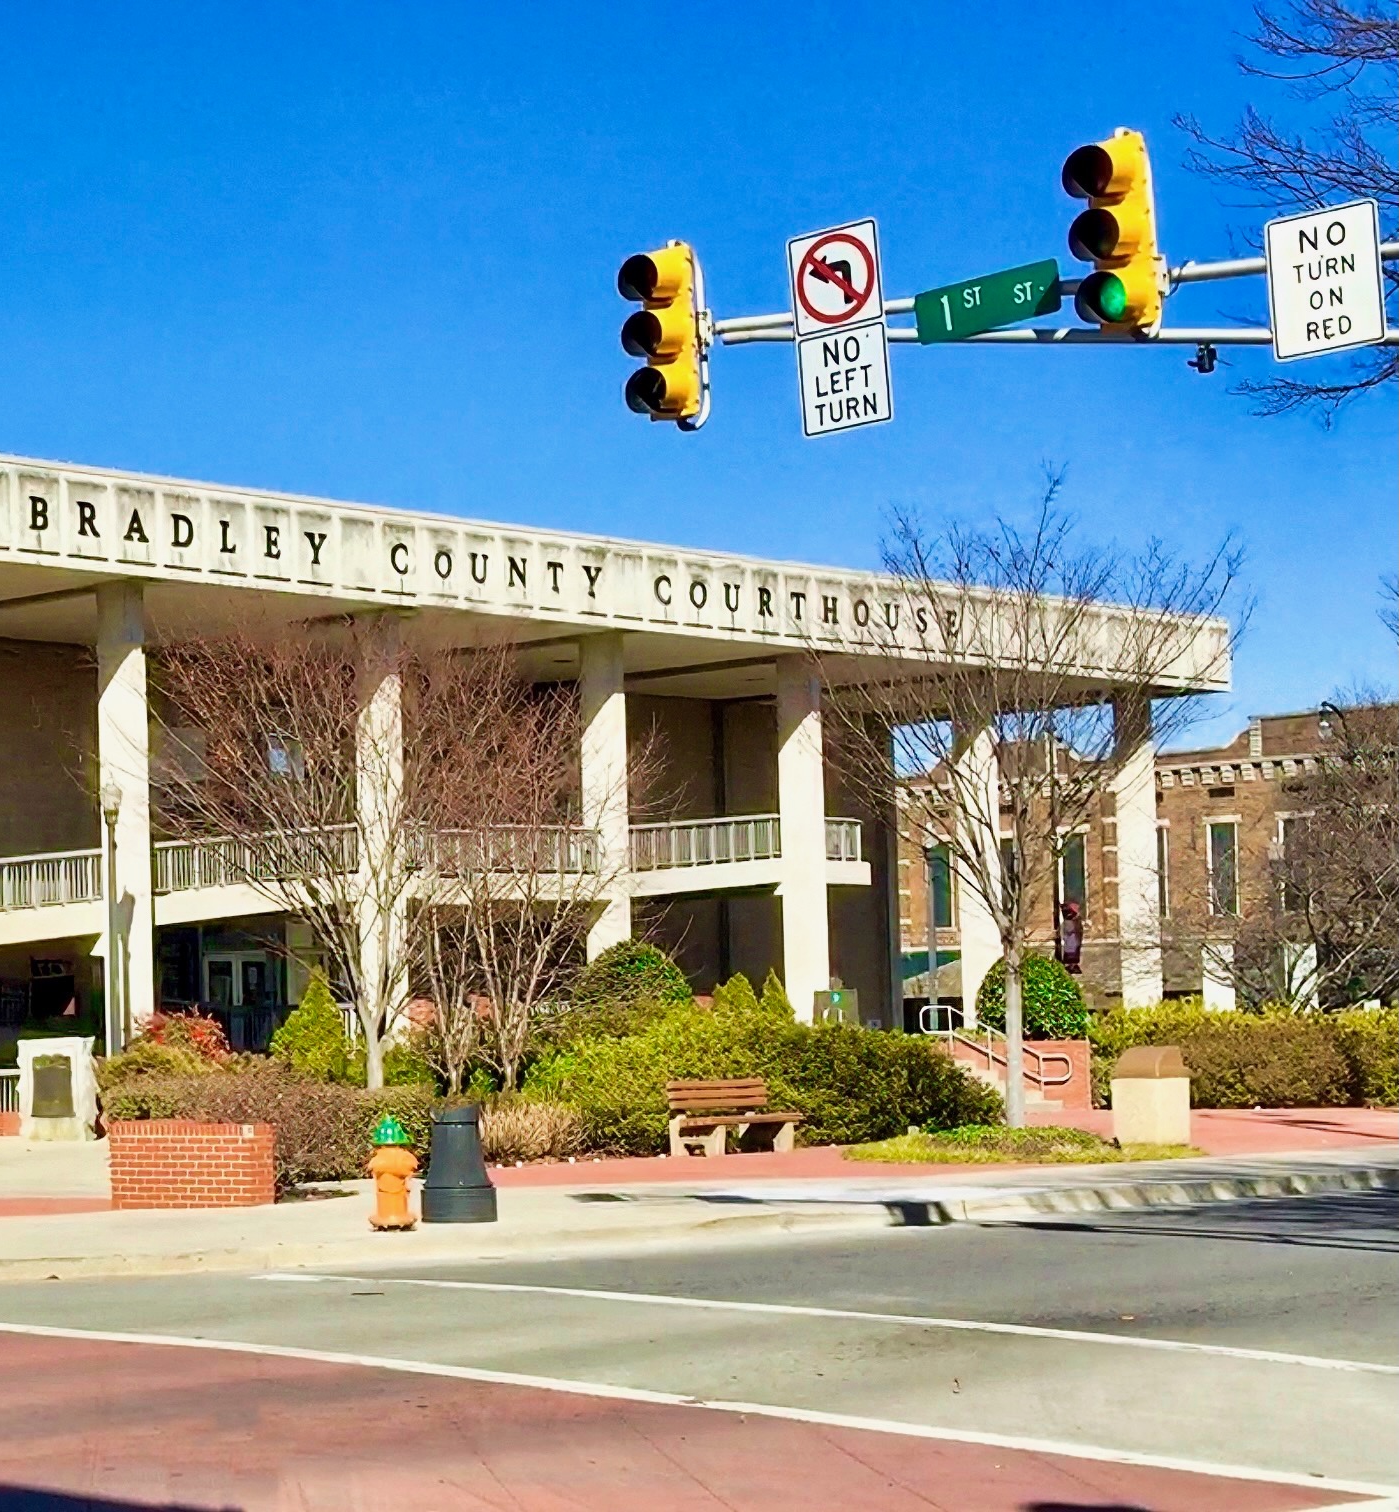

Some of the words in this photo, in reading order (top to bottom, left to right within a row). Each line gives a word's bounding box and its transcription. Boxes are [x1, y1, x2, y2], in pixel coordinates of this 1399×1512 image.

[1299, 221, 1346, 253] NO
[1292, 253, 1355, 283] TURN
[1013, 281, 1034, 305] ST
[1309, 286, 1343, 310] ON
[1306, 315, 1352, 341] RED
[822, 335, 861, 368] NO
[815, 364, 873, 398] LEFT
[814, 392, 879, 426] TURN
[28, 495, 328, 565] BRADLEY
[390, 543, 603, 599] COUNTY
[653, 574, 959, 638] COURTHOUSE
